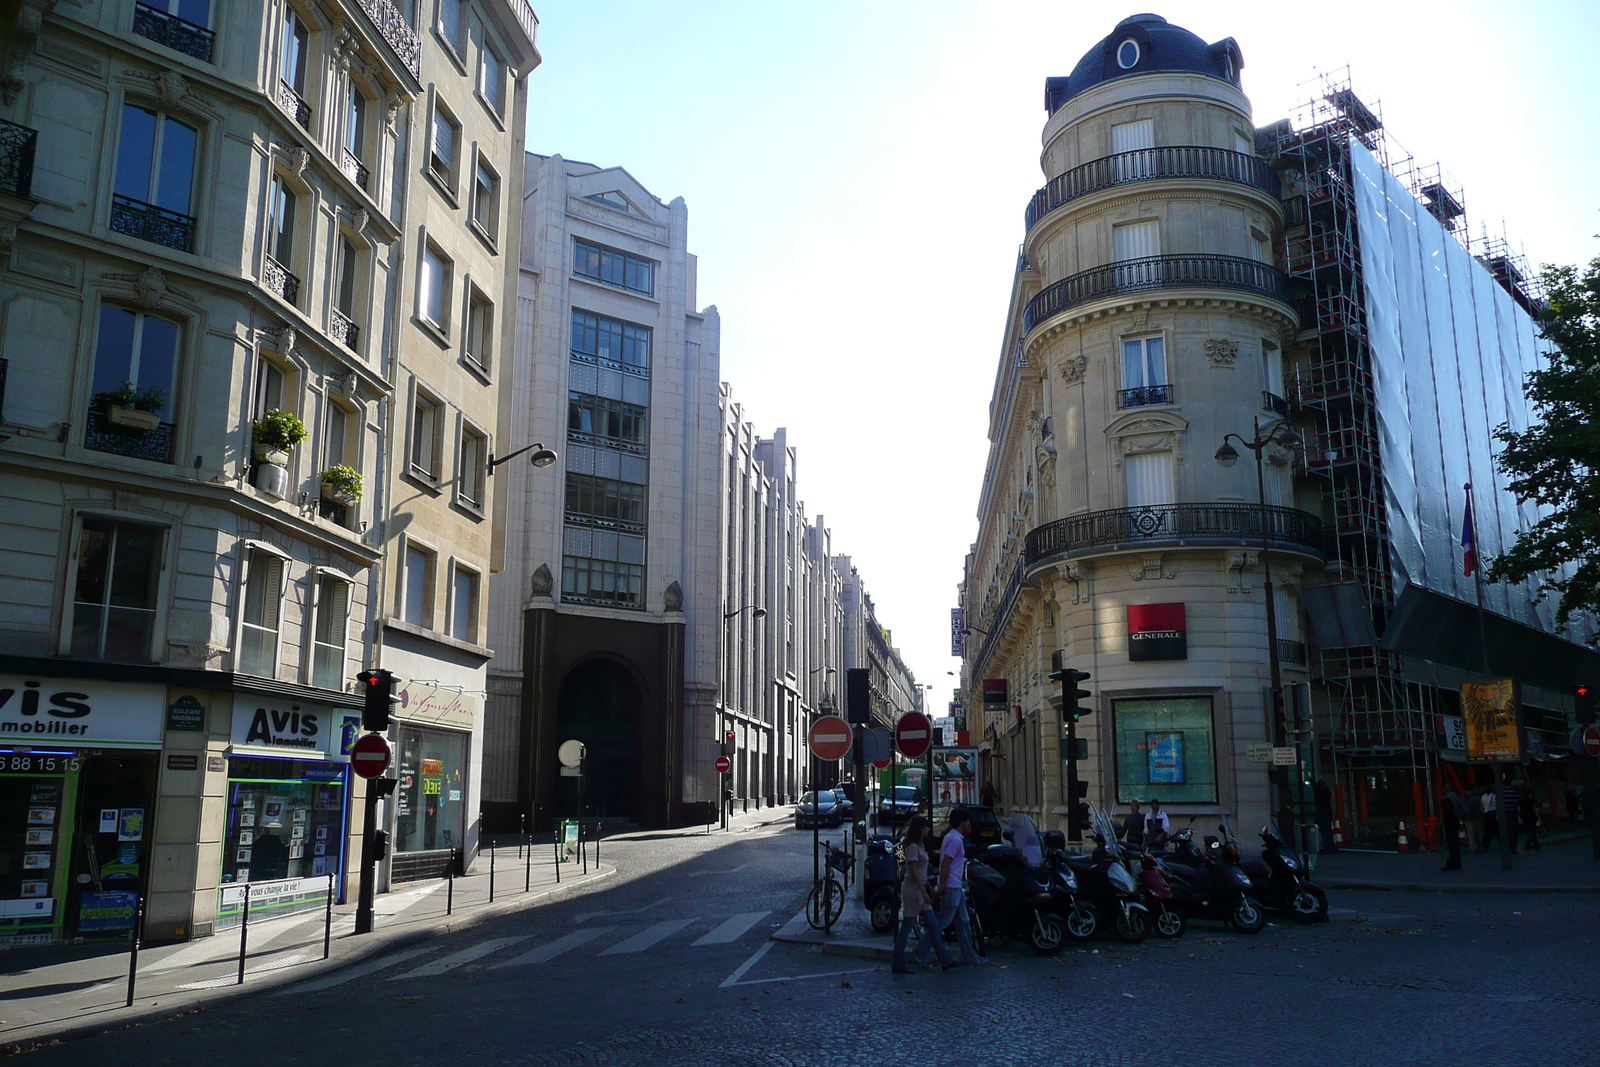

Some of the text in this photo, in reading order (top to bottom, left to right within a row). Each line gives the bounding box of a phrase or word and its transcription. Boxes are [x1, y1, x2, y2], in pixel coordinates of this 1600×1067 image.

[1131, 632, 1182, 641] GENERALE
[173, 707, 201, 715] BOULEVARD
[246, 705, 318, 744] Avis
[11, 757, 31, 771] 88
[37, 757, 56, 771] 15
[62, 758, 80, 771] 15
[250, 887, 264, 897] vous
[264, 884, 283, 895] change
[283, 883, 289, 892] la
[289, 882, 298, 891] vie
